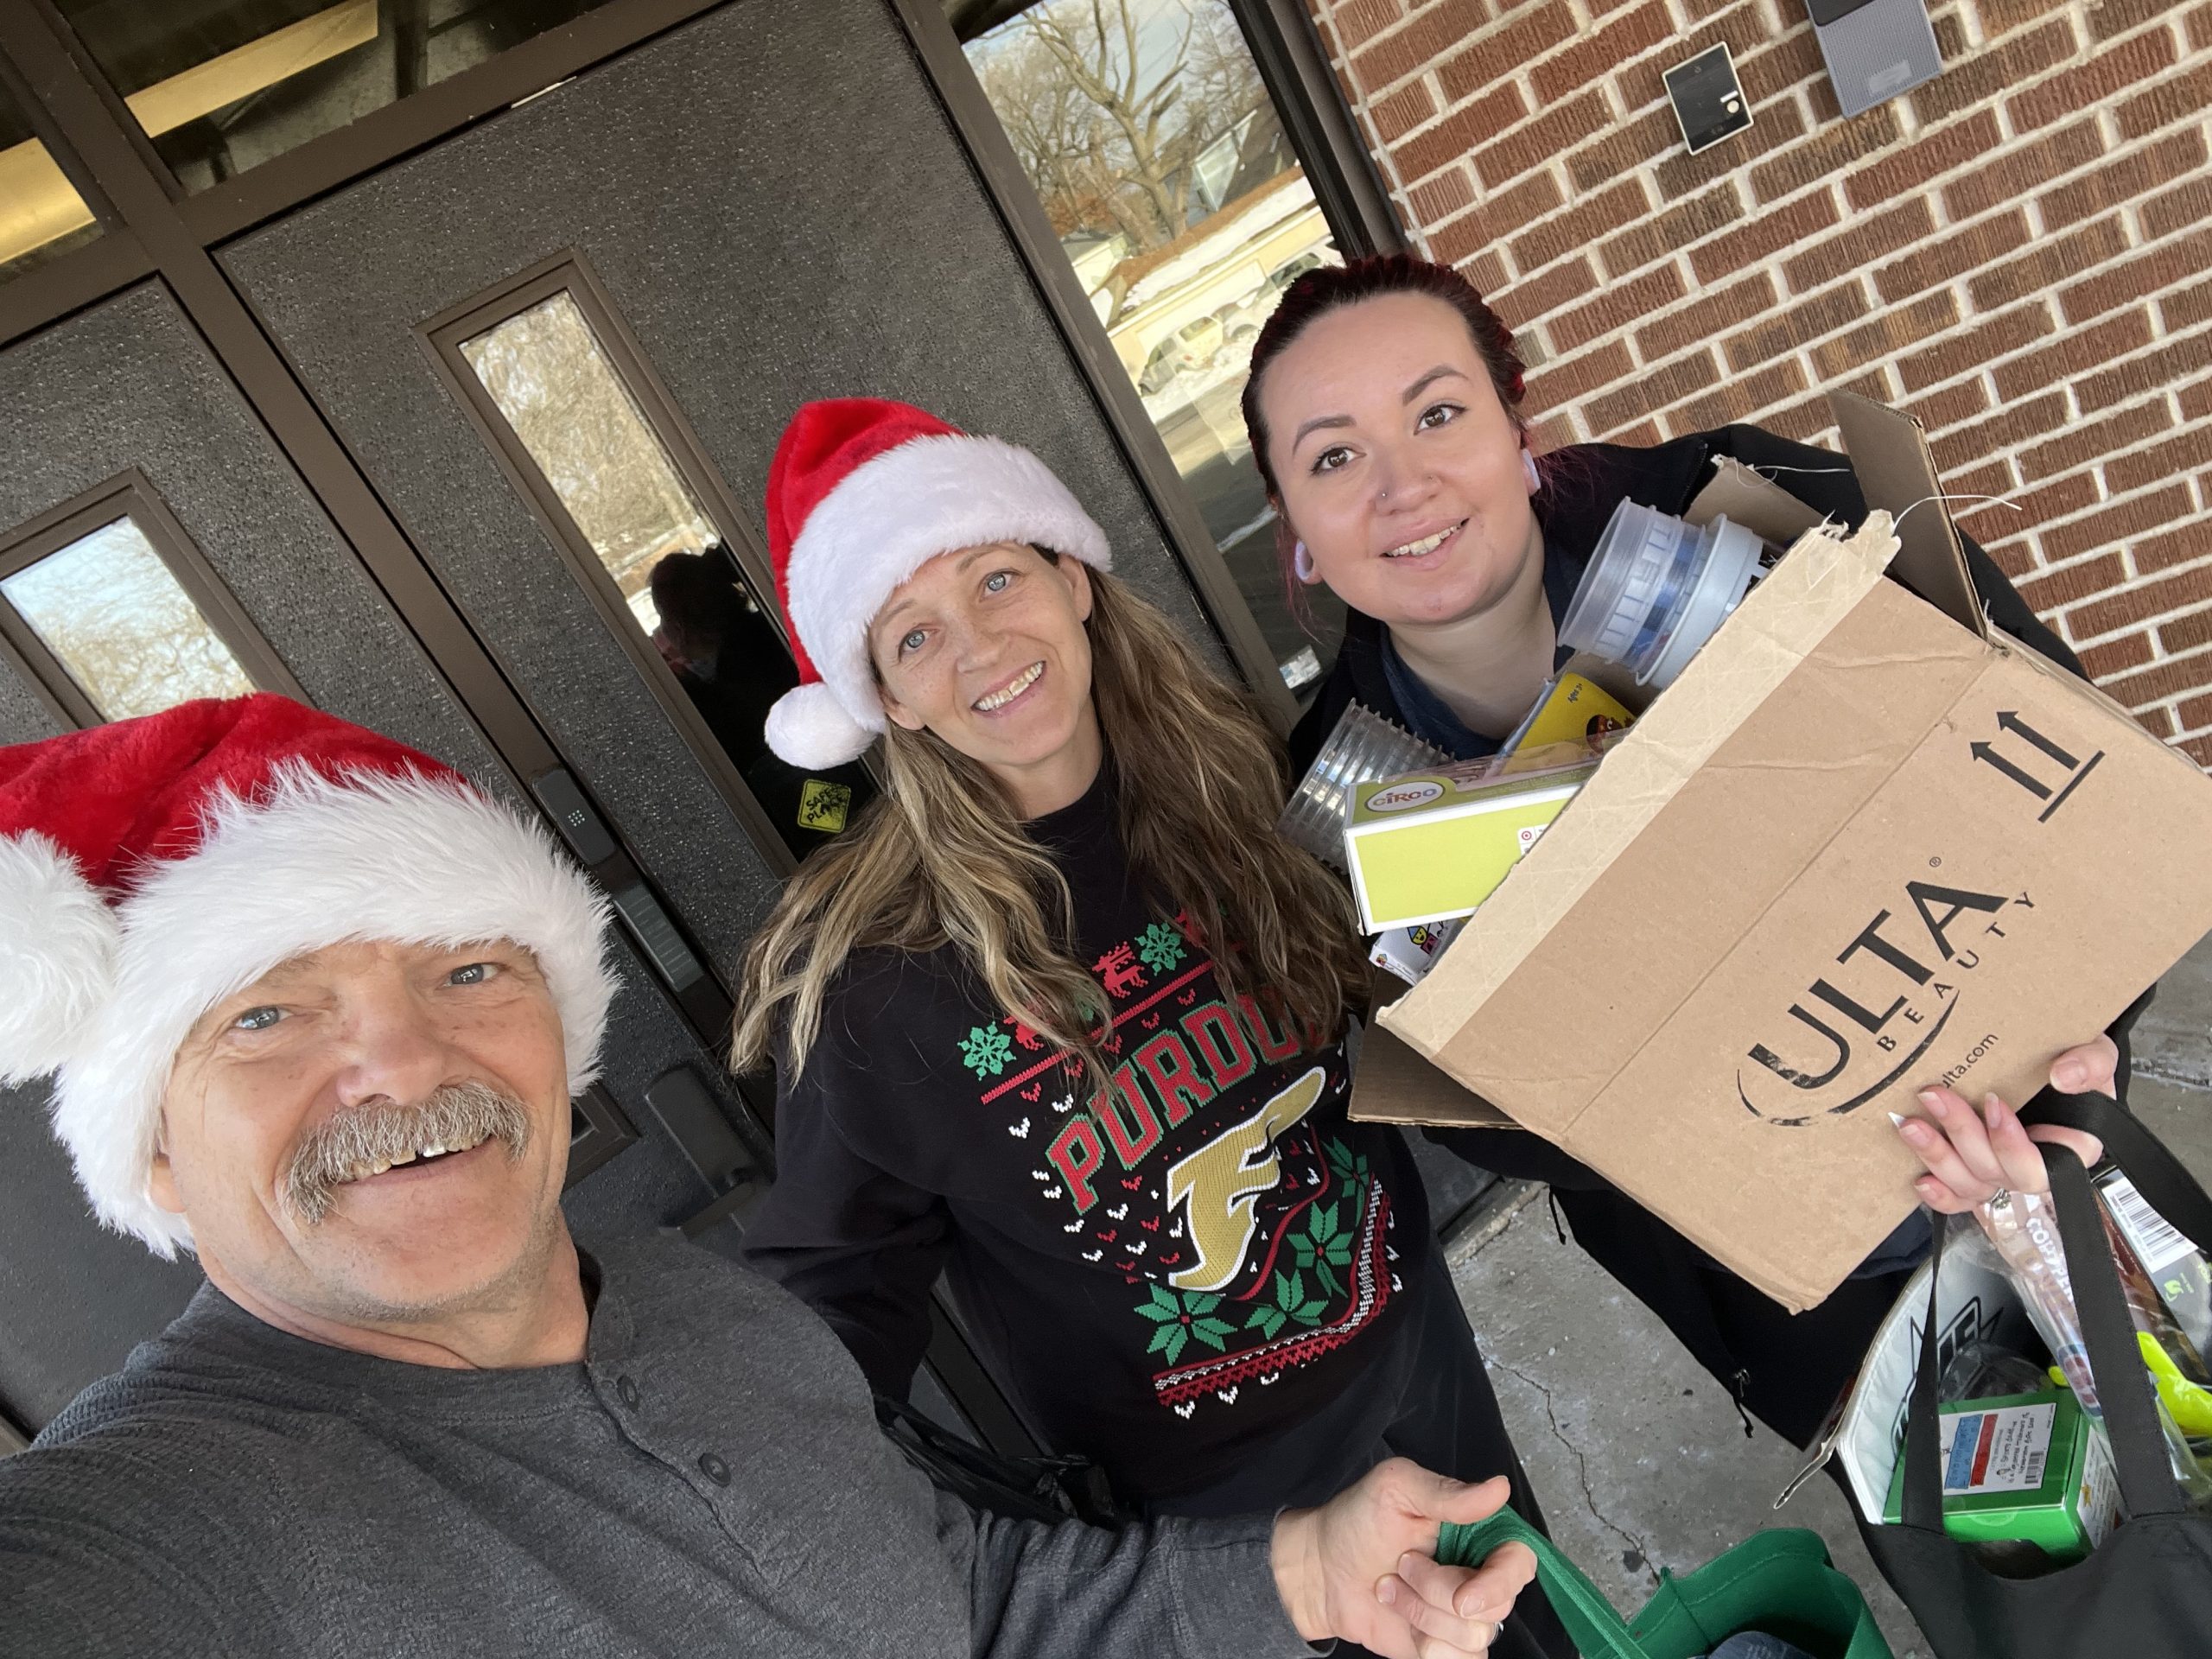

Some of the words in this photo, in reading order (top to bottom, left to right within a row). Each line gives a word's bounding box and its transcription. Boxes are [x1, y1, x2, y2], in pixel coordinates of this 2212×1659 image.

[1747, 880, 2009, 1090] ULTA
[1876, 892, 2036, 1052] BEAUTY
[1046, 988, 1325, 1215] PURDU
